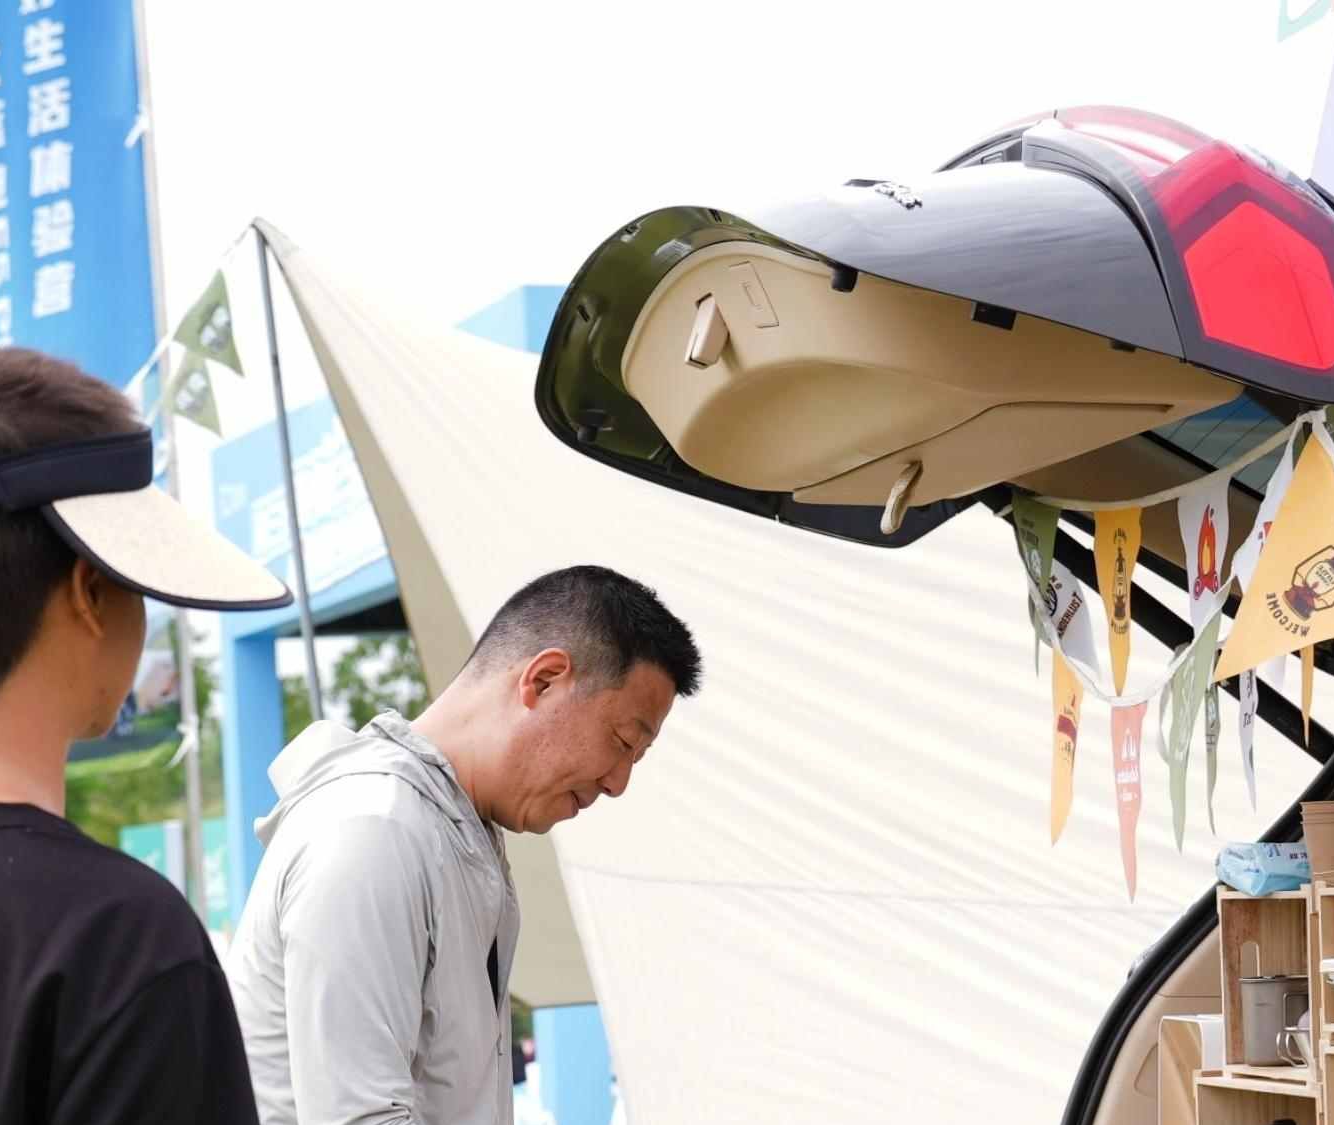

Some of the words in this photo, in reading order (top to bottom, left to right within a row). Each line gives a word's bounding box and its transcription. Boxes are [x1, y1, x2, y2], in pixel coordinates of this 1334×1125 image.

[18, 0, 75, 319] 生活体验营
